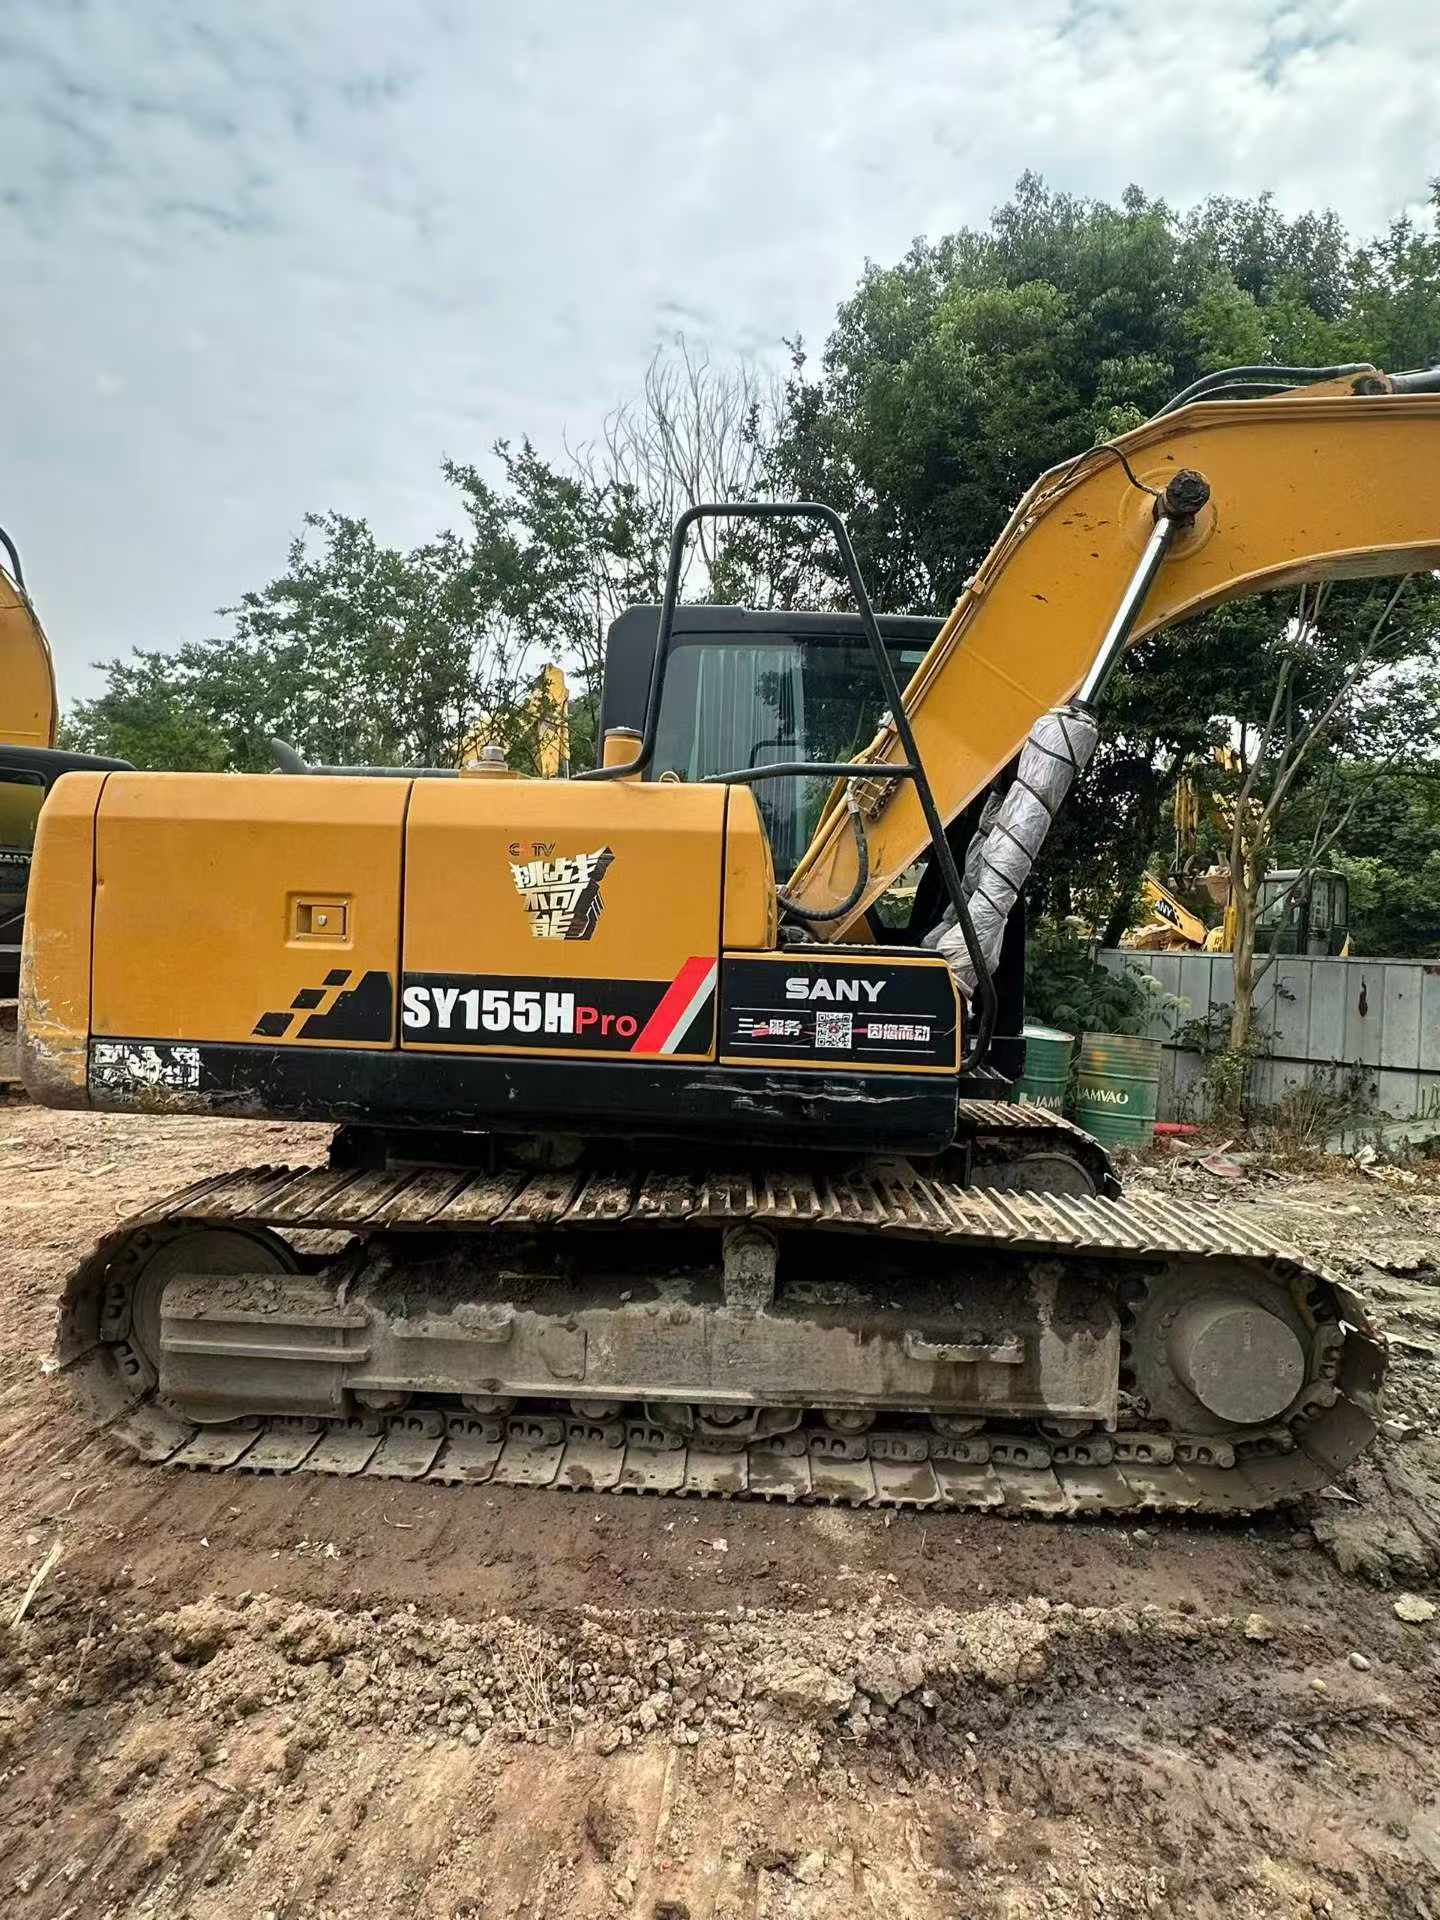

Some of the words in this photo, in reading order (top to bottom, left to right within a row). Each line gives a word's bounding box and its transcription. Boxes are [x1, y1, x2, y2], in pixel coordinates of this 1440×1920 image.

[0, 854, 33, 864] ANY
[1154, 899, 1173, 917] ANY
[785, 977, 887, 1003] SANY
[402, 985, 575, 1034] SY155H
[575, 1006, 638, 1037] Pro
[737, 1017, 801, 1037] 三一服务
